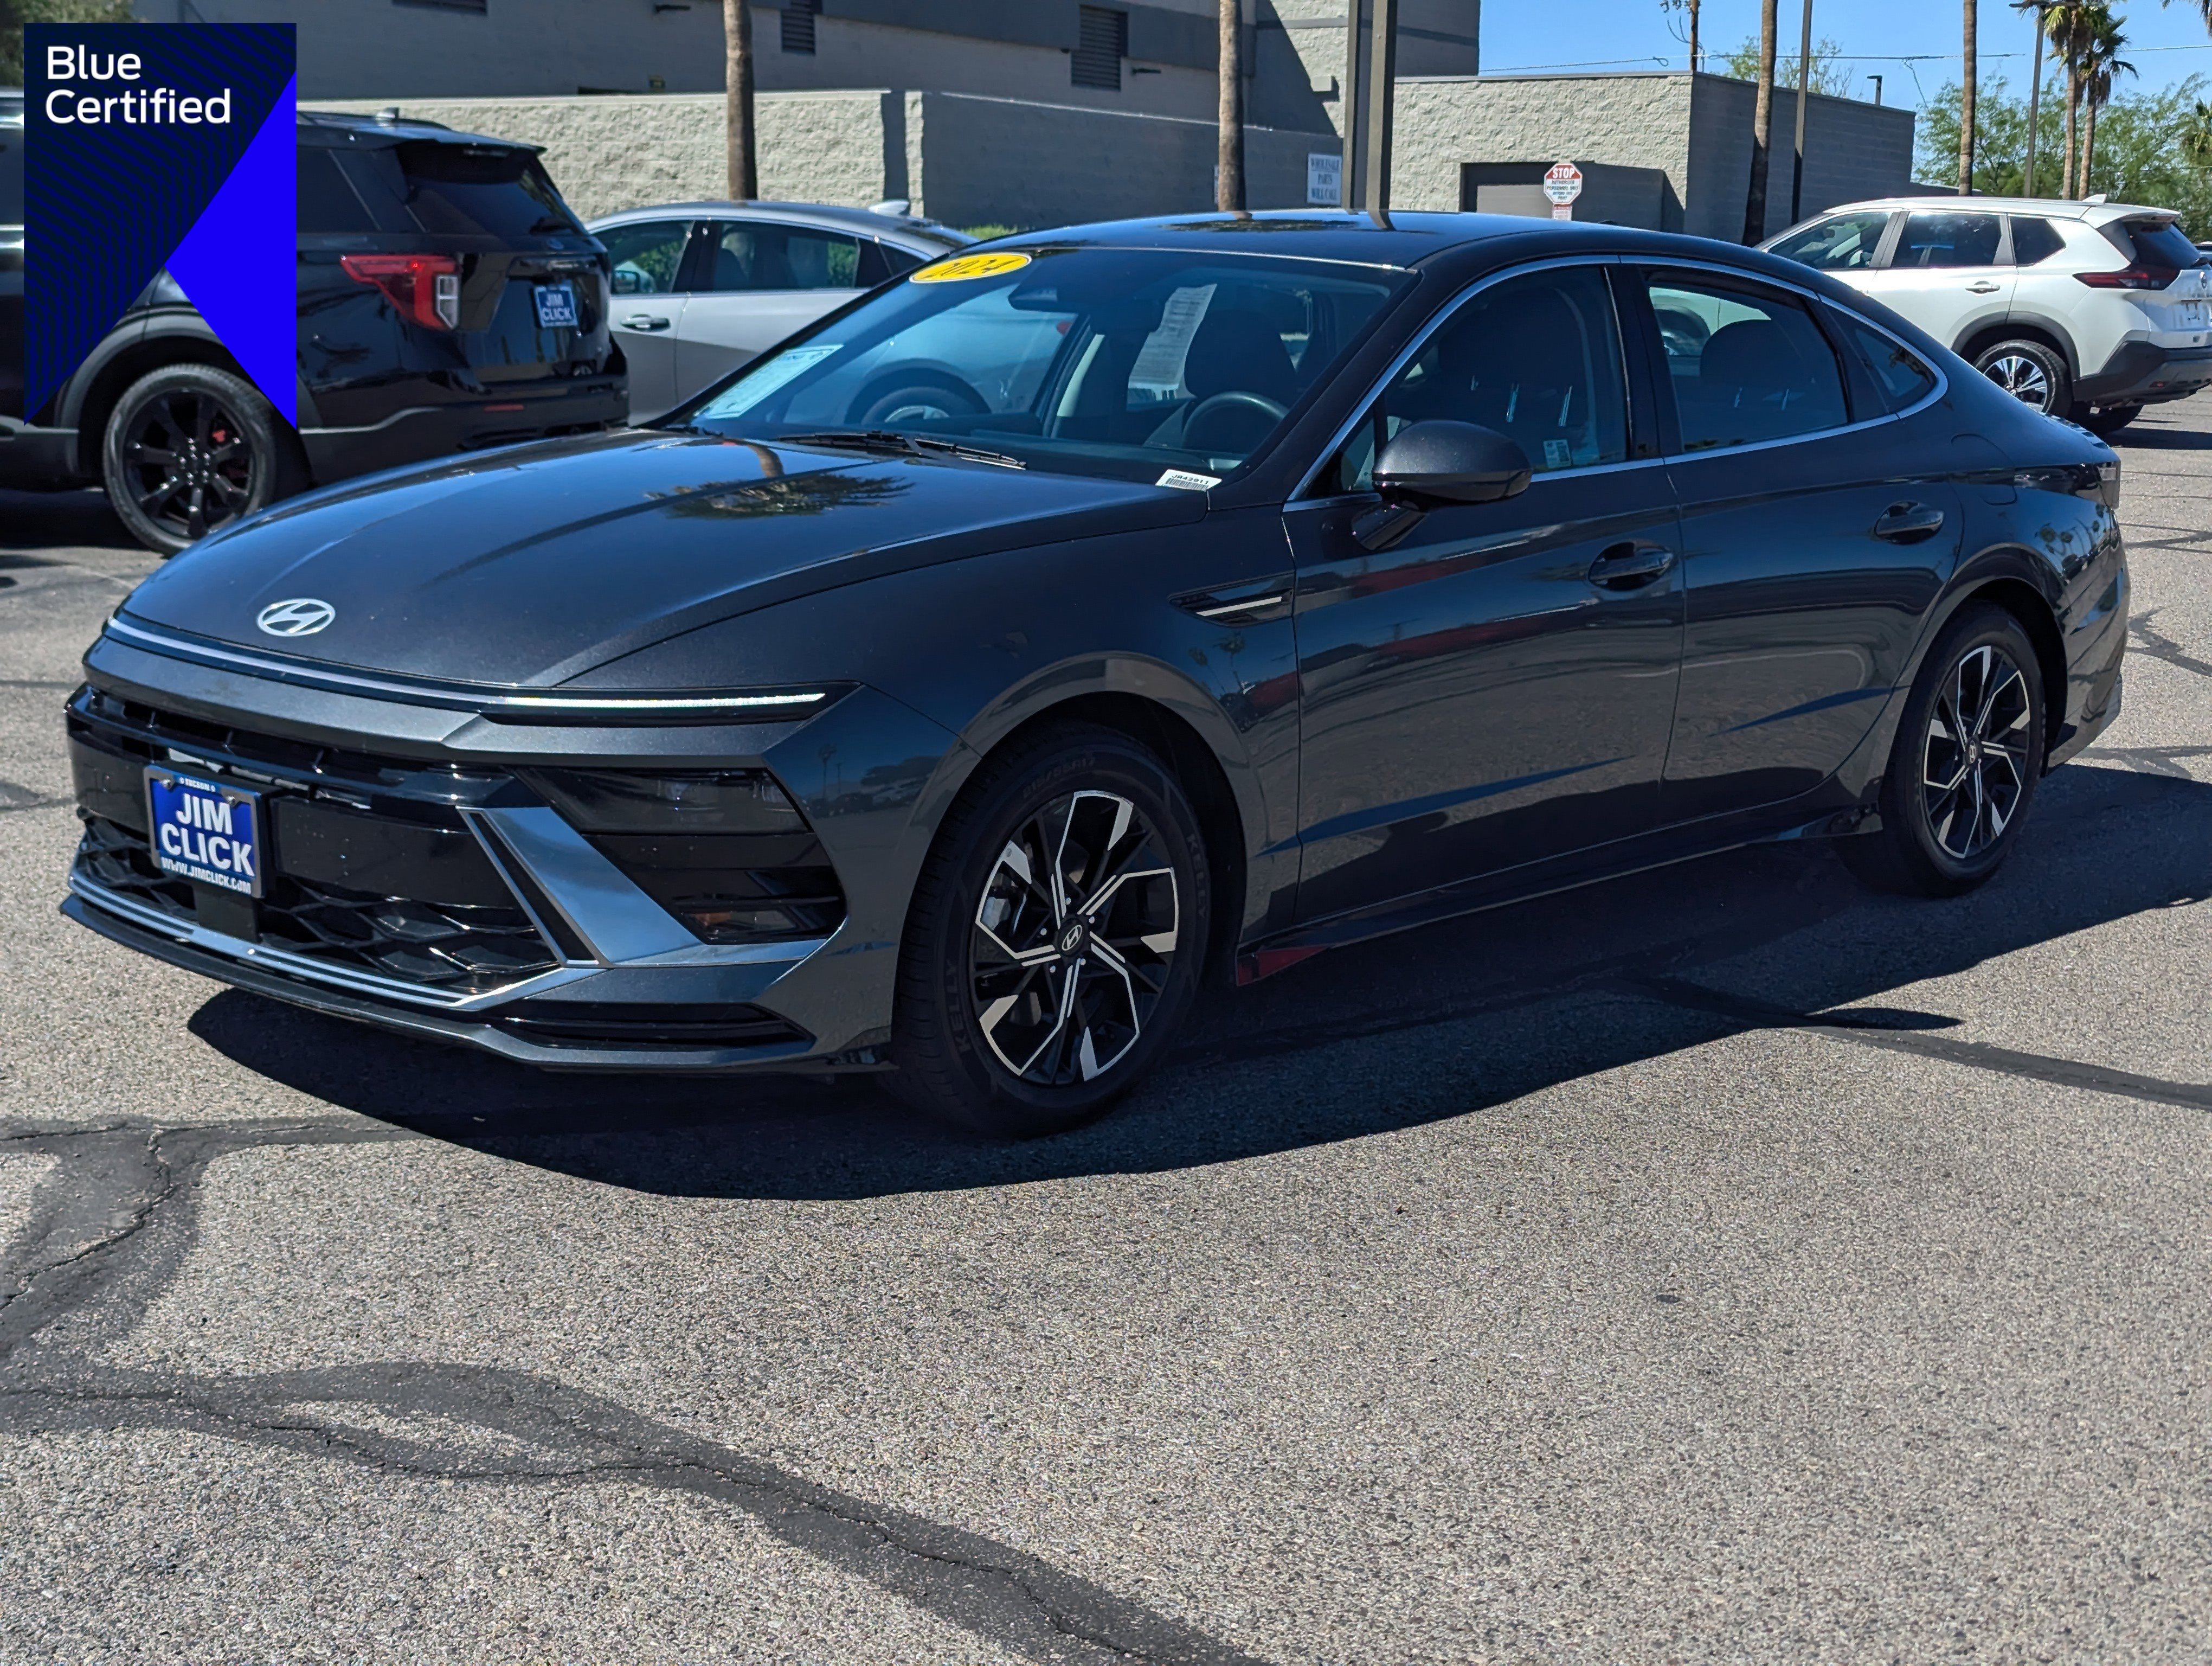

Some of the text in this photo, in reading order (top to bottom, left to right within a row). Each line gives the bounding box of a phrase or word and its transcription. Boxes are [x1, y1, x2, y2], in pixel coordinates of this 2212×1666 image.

[1552, 168, 1575, 179] STOP
[921, 258, 1020, 279] 2024
[543, 307, 572, 321] CLICK
[546, 293, 564, 306] JIM
[176, 793, 233, 835] JIM
[160, 823, 255, 877] CLICK
[160, 856, 252, 895] WWW.JIMCLICK.COM
[1186, 834, 1206, 919] KELLY
[946, 959, 972, 1053] KELLY
